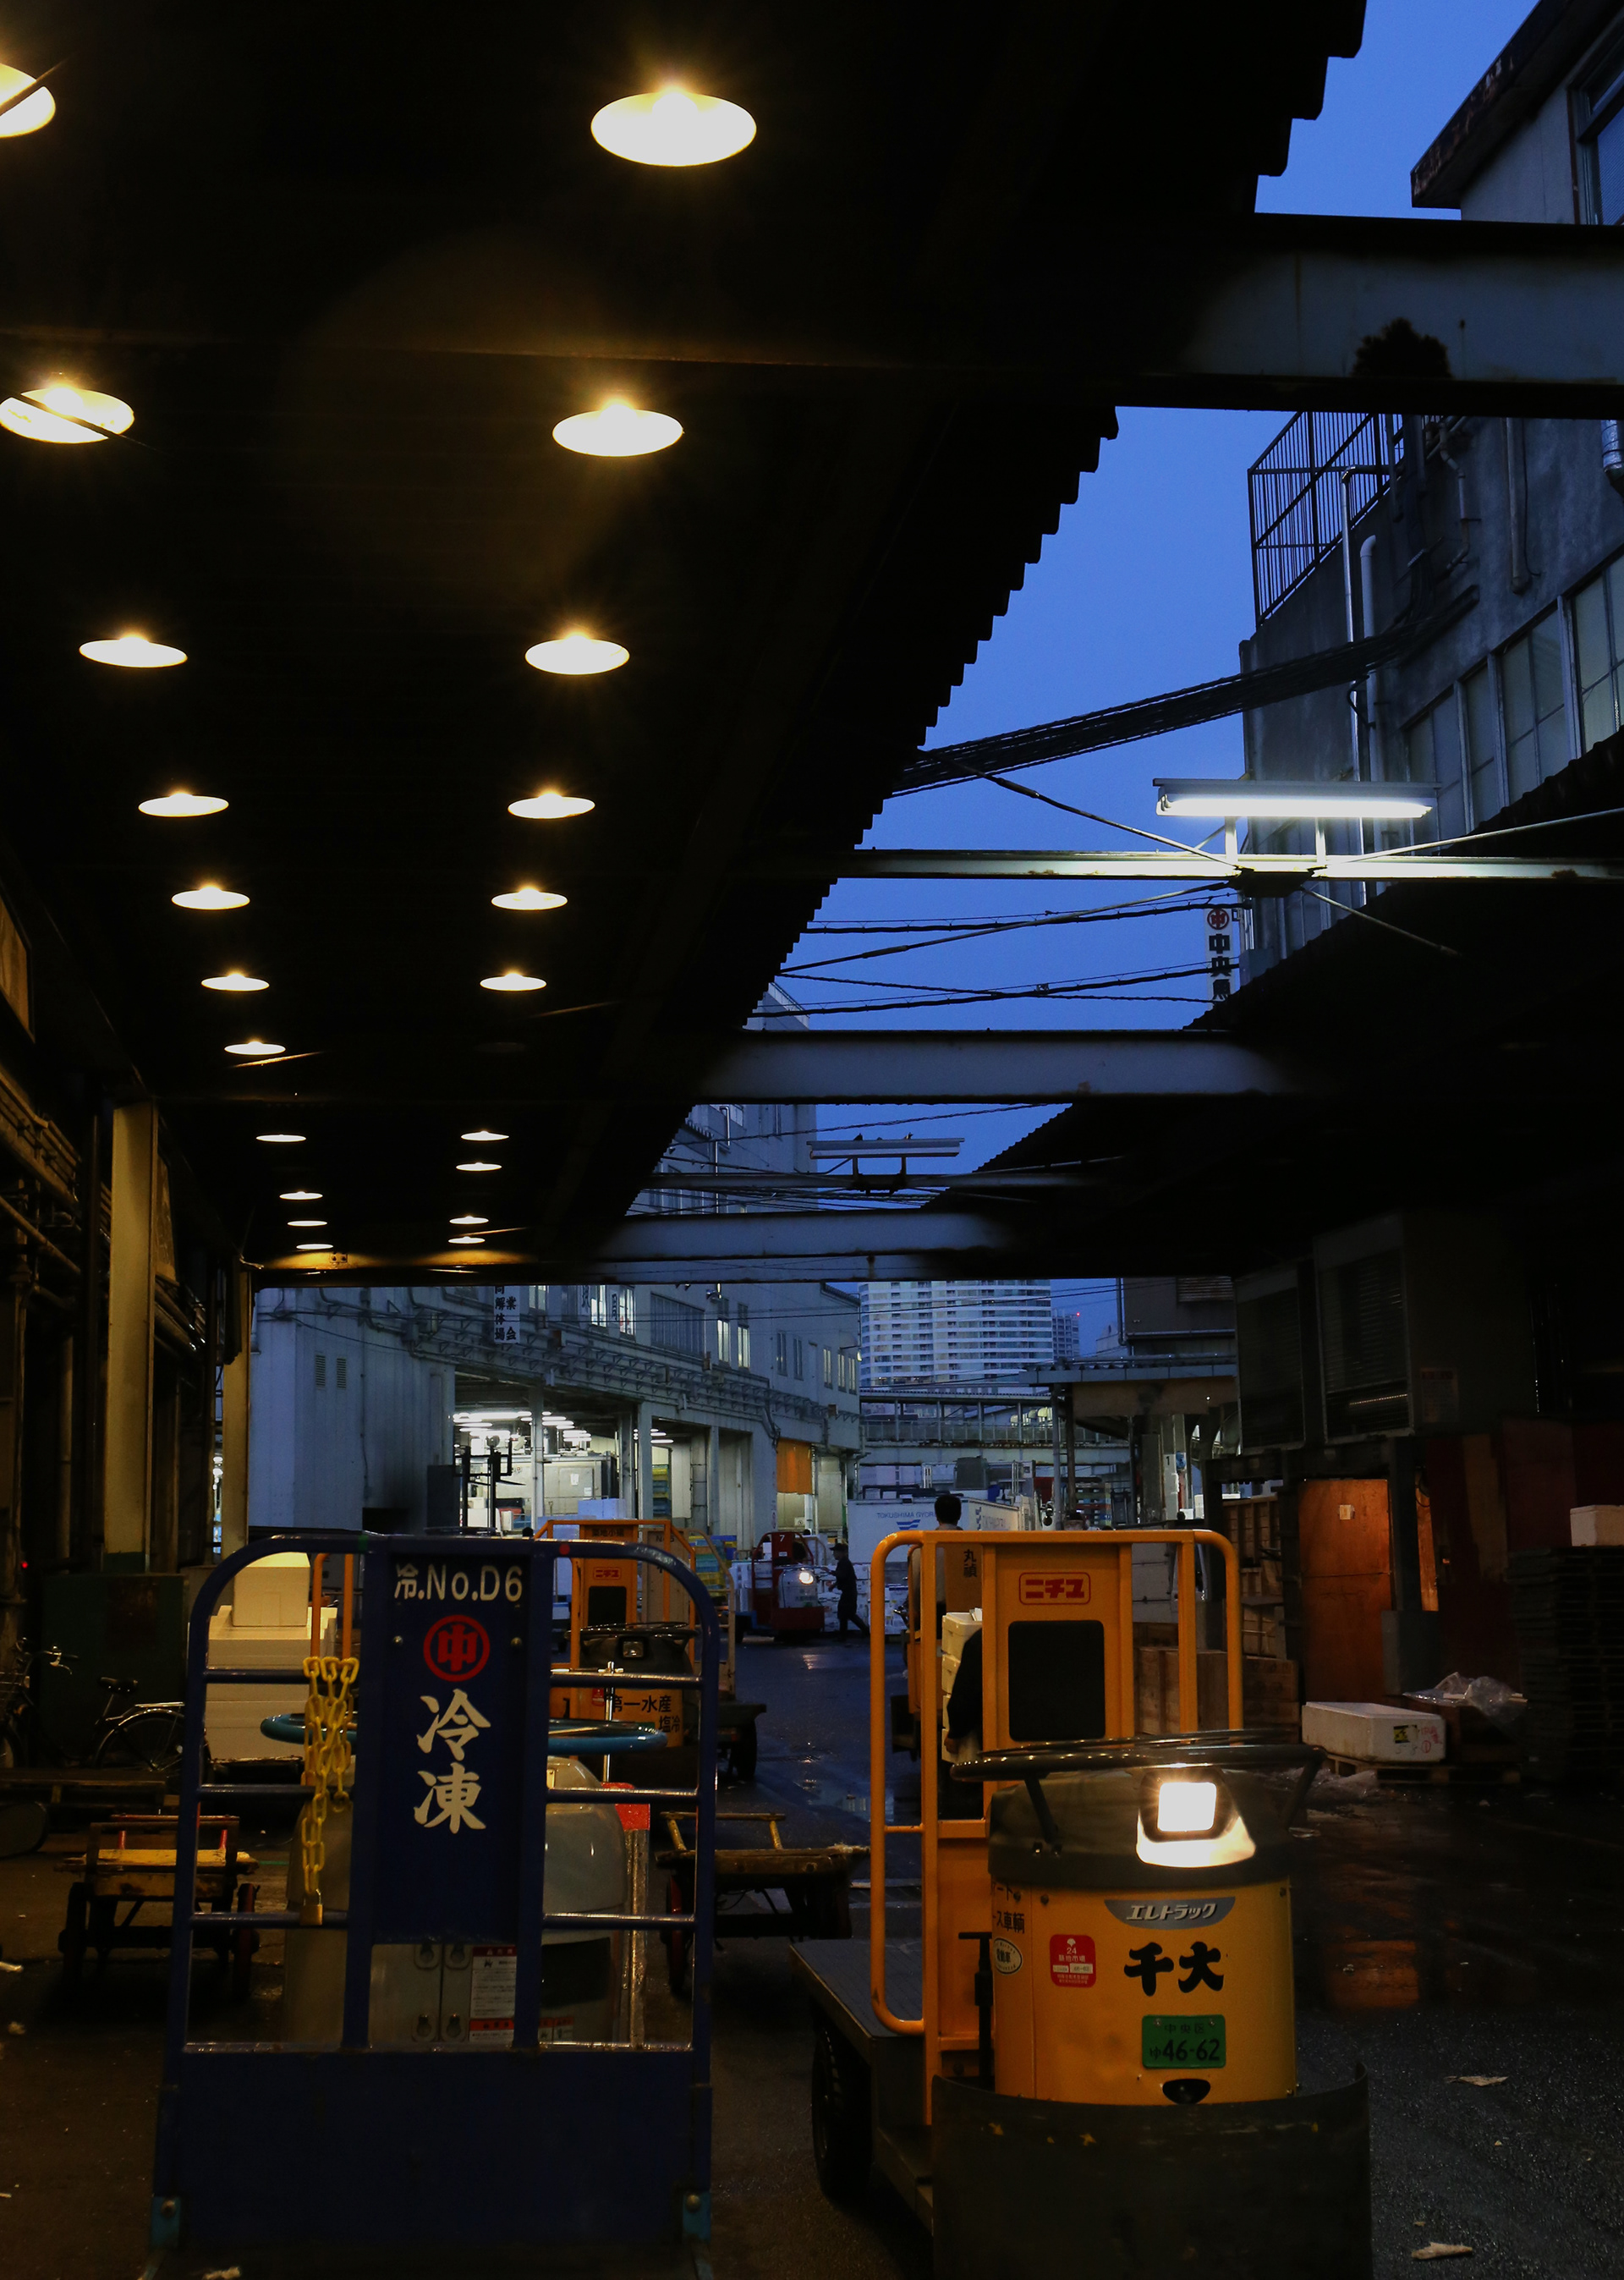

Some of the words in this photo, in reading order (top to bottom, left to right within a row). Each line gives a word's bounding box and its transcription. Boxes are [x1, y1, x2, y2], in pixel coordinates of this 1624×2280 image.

[779, 1534, 785, 1542] 7
[595, 1569, 619, 1578] ニチユ
[1025, 1579, 1084, 1599] ニチユ
[612, 1695, 672, 1713] 第一水産
[413, 1688, 491, 1834] 冷凍
[1126, 1903, 1217, 1920] エレトラック
[1124, 1942, 1224, 1997] 千大
[1165, 2023, 1205, 2034] 中央区
[1162, 2038, 1220, 2061] 46-62
